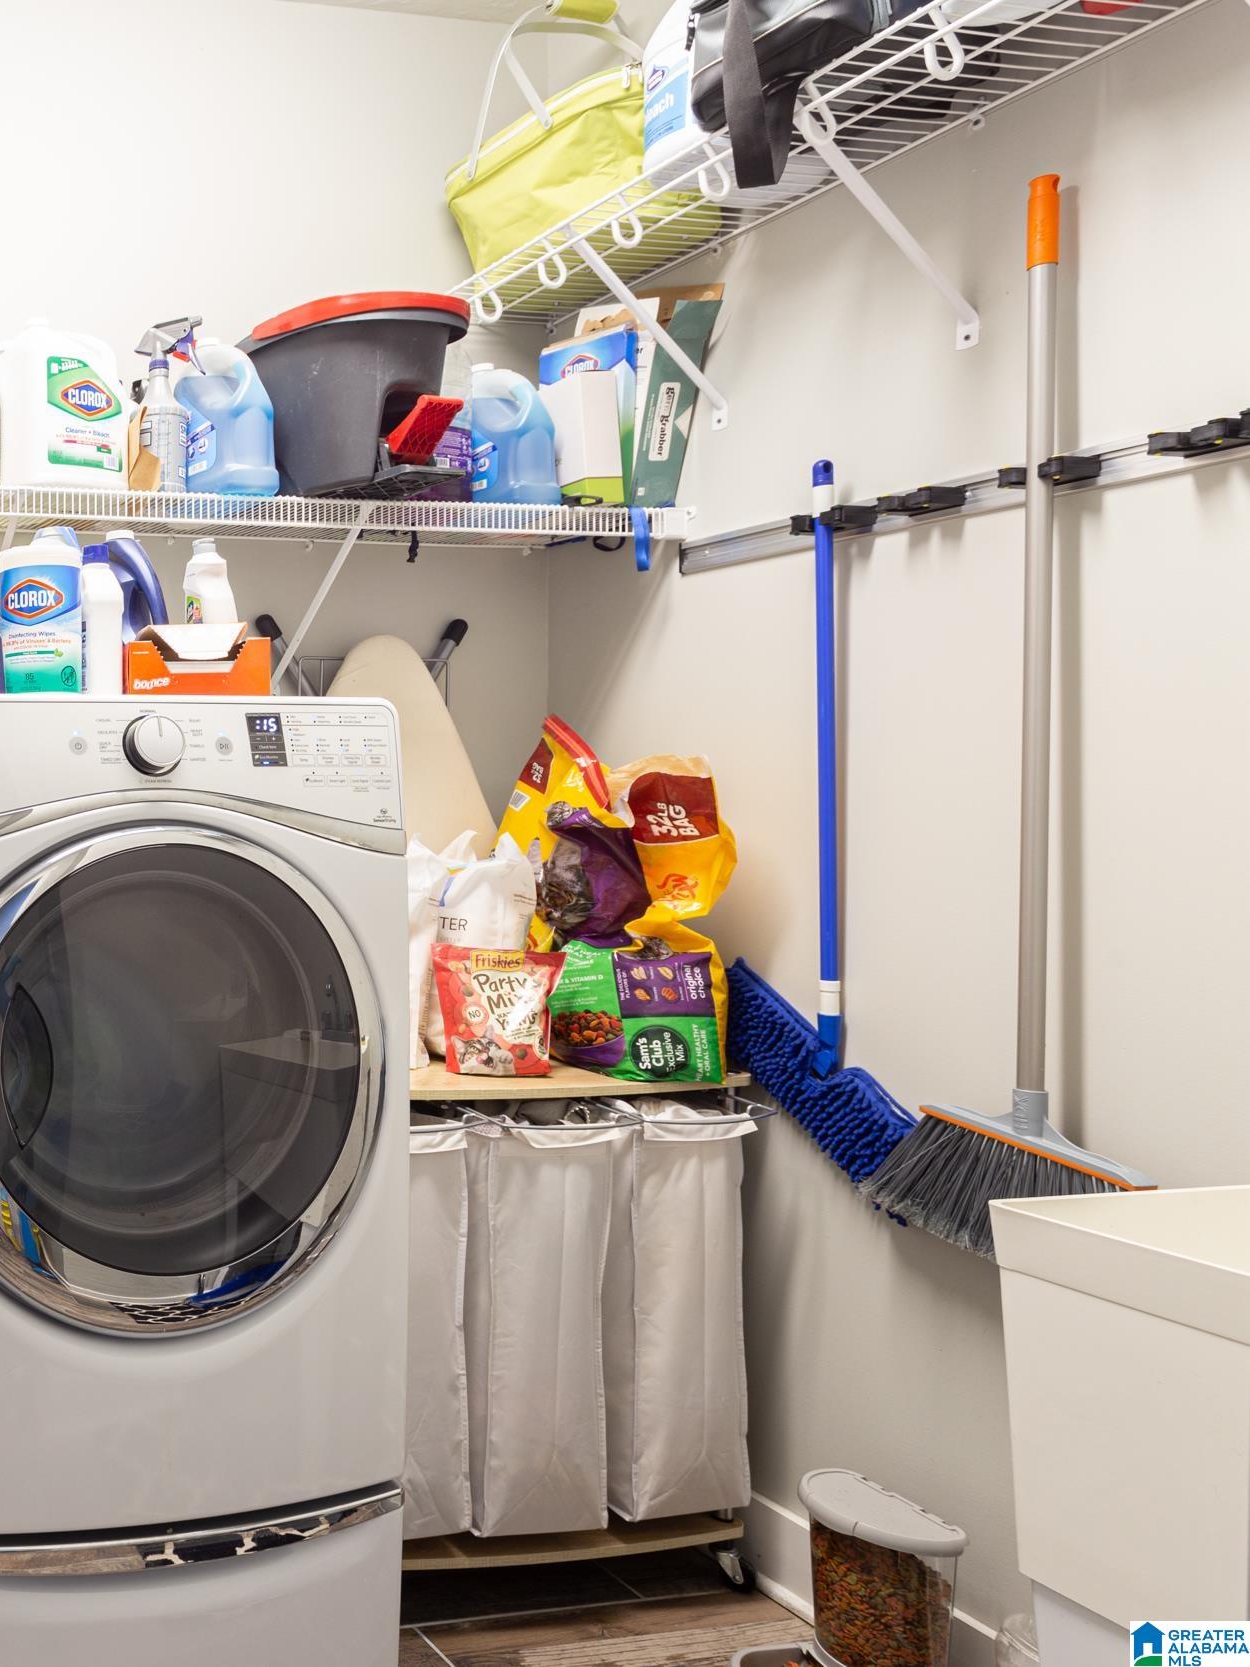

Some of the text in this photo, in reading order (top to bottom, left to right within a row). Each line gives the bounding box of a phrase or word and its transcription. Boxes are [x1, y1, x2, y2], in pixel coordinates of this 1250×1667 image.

[68, 388, 107, 409] CLOROX
[8, 589, 56, 610] CLOROX
[8, 631, 37, 639] Disinfecting
[133, 677, 170, 690] bounce
[669, 804, 700, 836] BAG
[475, 953, 520, 968] Friskies
[684, 964, 698, 1000] original
[694, 966, 706, 999] choice
[468, 1009, 481, 1019] NO
[692, 1023, 701, 1056] HEALTHY
[635, 1037, 651, 1070] Sam's
[649, 1039, 664, 1067] Club
[662, 1031, 676, 1072] Exclusive
[675, 1044, 686, 1062] Mix
[702, 1051, 710, 1071] ORAL
